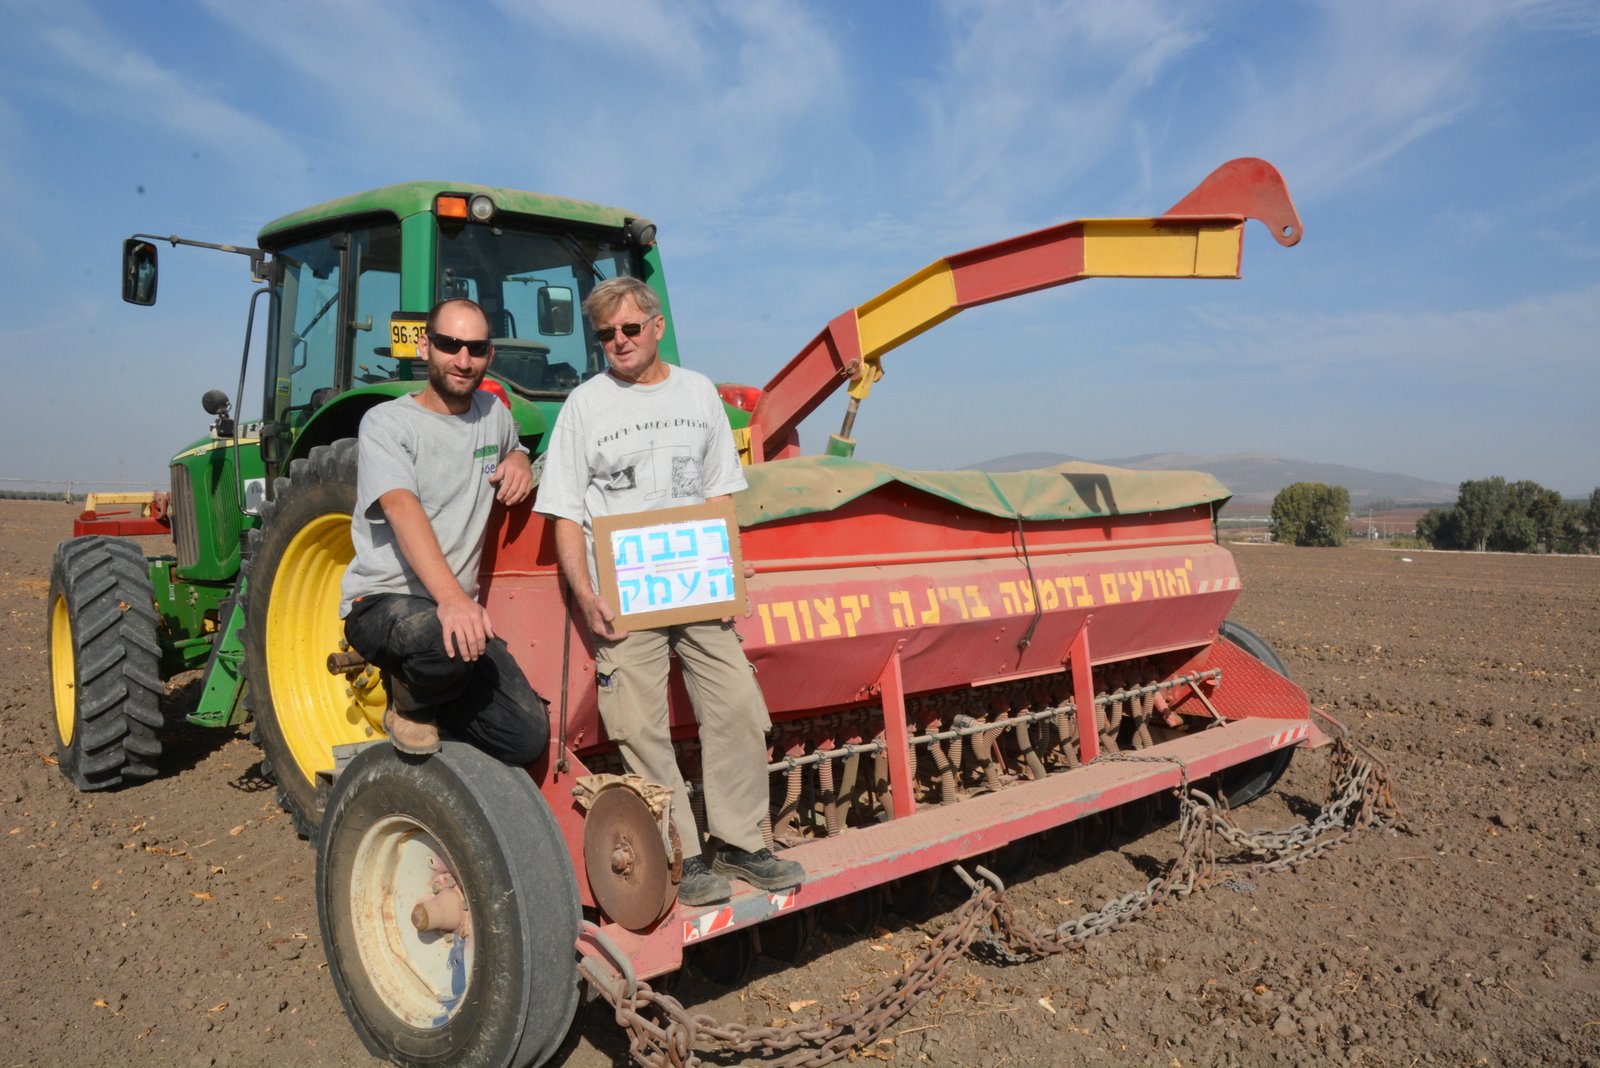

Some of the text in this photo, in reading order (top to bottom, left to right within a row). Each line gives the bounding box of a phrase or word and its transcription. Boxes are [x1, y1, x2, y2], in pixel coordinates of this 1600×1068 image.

[615, 525, 730, 566] רכבת
[619, 567, 736, 612] העמק
[888, 585, 991, 628] ברינה
[757, 594, 871, 645] יקצורו
